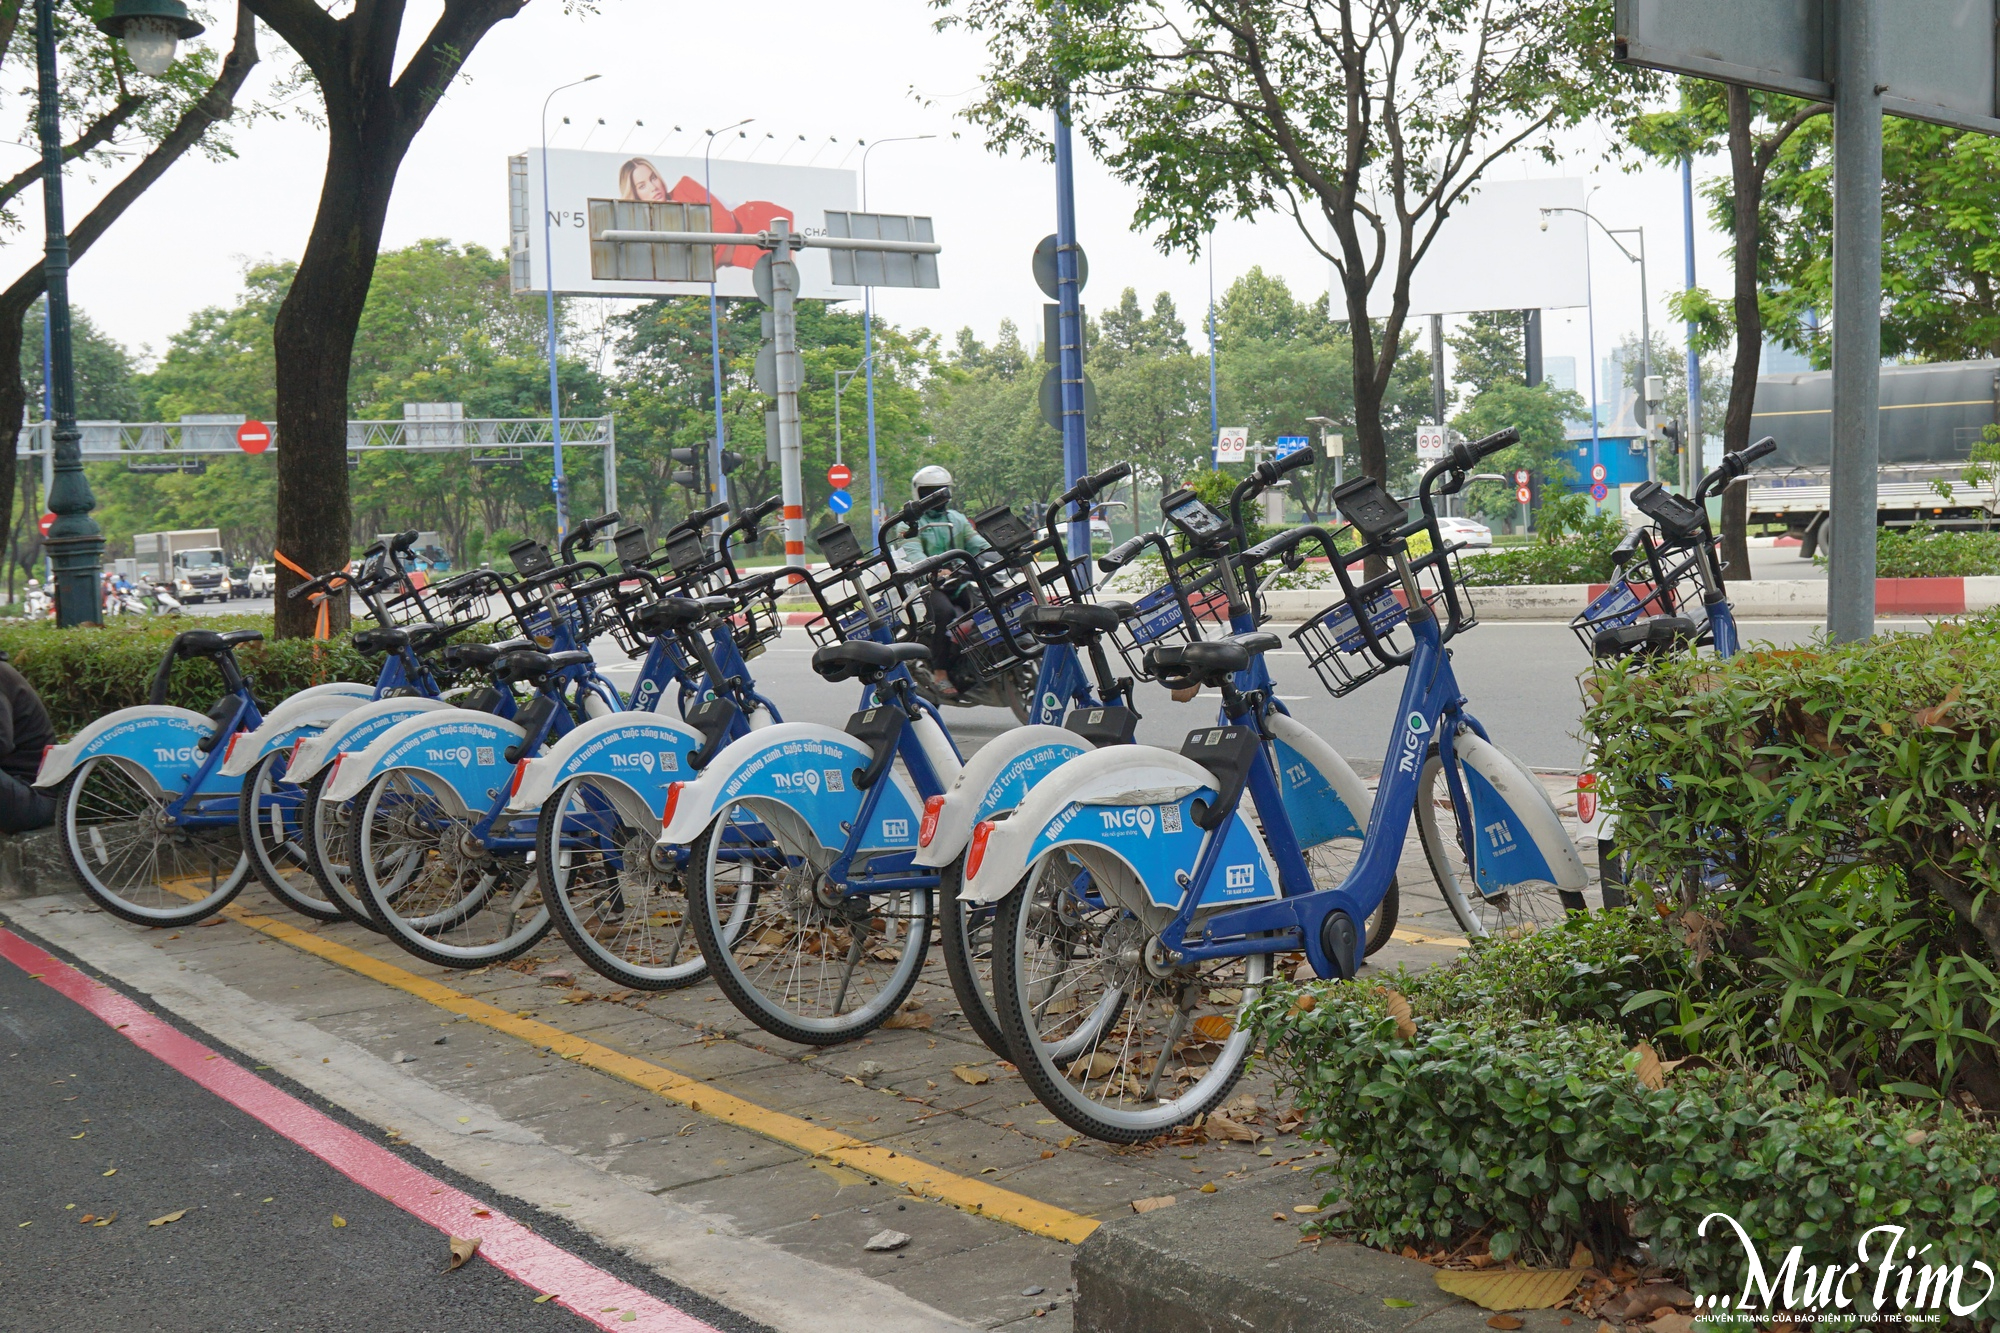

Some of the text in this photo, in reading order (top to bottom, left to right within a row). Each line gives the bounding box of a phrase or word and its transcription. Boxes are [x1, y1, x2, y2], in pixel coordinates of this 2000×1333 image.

[804, 228, 828, 236] CHA
[87, 738, 105, 754] Môi
[104, 720, 136, 740] trường
[136, 718, 159, 729] xanh
[168, 718, 192, 731] Cuộc
[338, 739, 351, 752] Môi
[350, 722, 374, 742] trường
[383, 753, 399, 767] Môi
[397, 737, 420, 756] trường
[440, 724, 458, 736] Cuộc
[459, 724, 478, 736] sống
[566, 756, 581, 773] Môi
[580, 740, 604, 761] trường
[621, 728, 639, 739] Cuộc
[640, 727, 659, 740] sống
[660, 731, 678, 744] khỏe
[726, 778, 743, 797] Môi
[740, 758, 765, 784] trường
[782, 742, 803, 756] Cuộc
[803, 741, 823, 753] sống
[824, 745, 843, 760] khỏe
[985, 783, 1004, 809] Môi
[1001, 756, 1034, 787] trường
[1032, 748, 1055, 764] xanh
[1286, 763, 1307, 783] TN
[1045, 818, 1065, 842] Môi
[1484, 820, 1512, 848] TN
